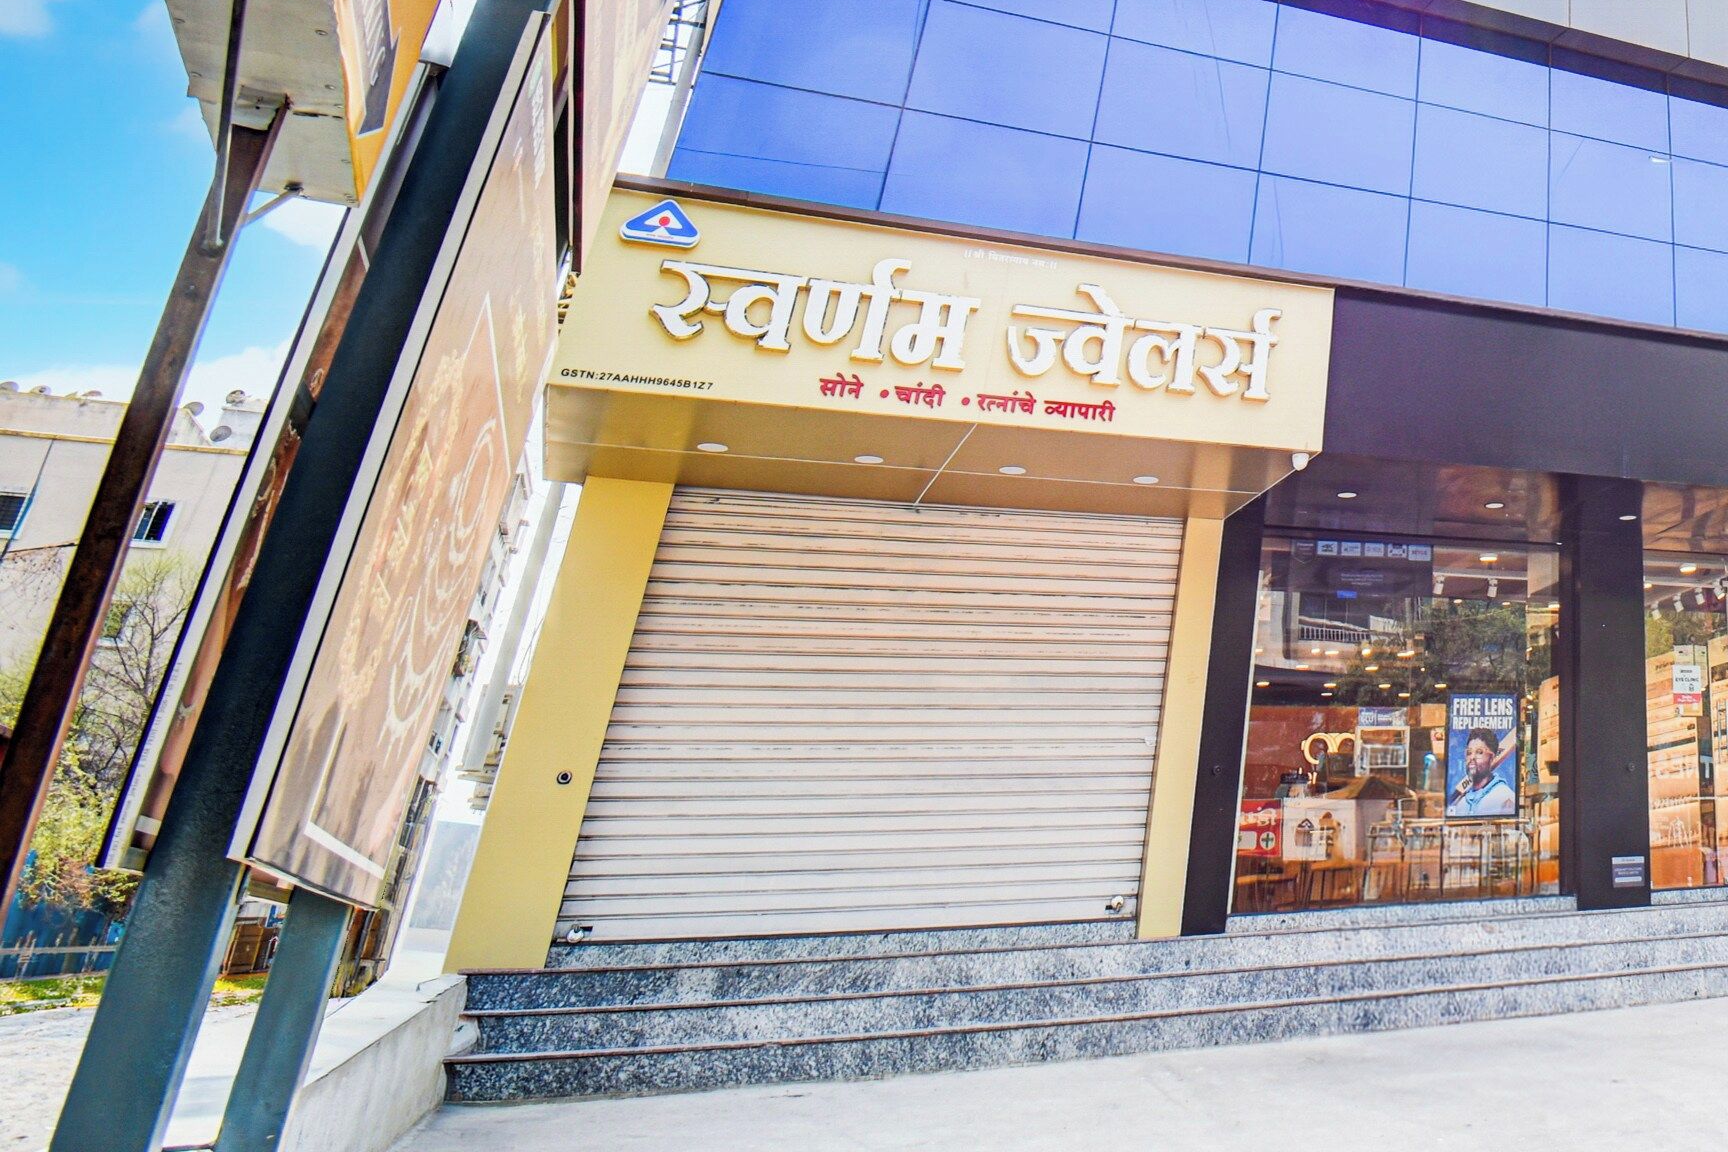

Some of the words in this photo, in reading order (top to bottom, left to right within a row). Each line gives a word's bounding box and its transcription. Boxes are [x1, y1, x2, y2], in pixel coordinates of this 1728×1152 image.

[650, 258, 980, 372] स्वर्णम
[1007, 284, 1283, 401] ज्वेलर्स
[820, 372, 864, 399] सोने
[895, 381, 945, 408] चांदी
[977, 390, 1036, 414] रत्नांचे
[1044, 399, 1115, 421] व्यापारी
[1452, 716, 1513, 730] REPLACEMENT
[1453, 698, 1481, 716] FREE
[1484, 698, 1513, 716] LENS
